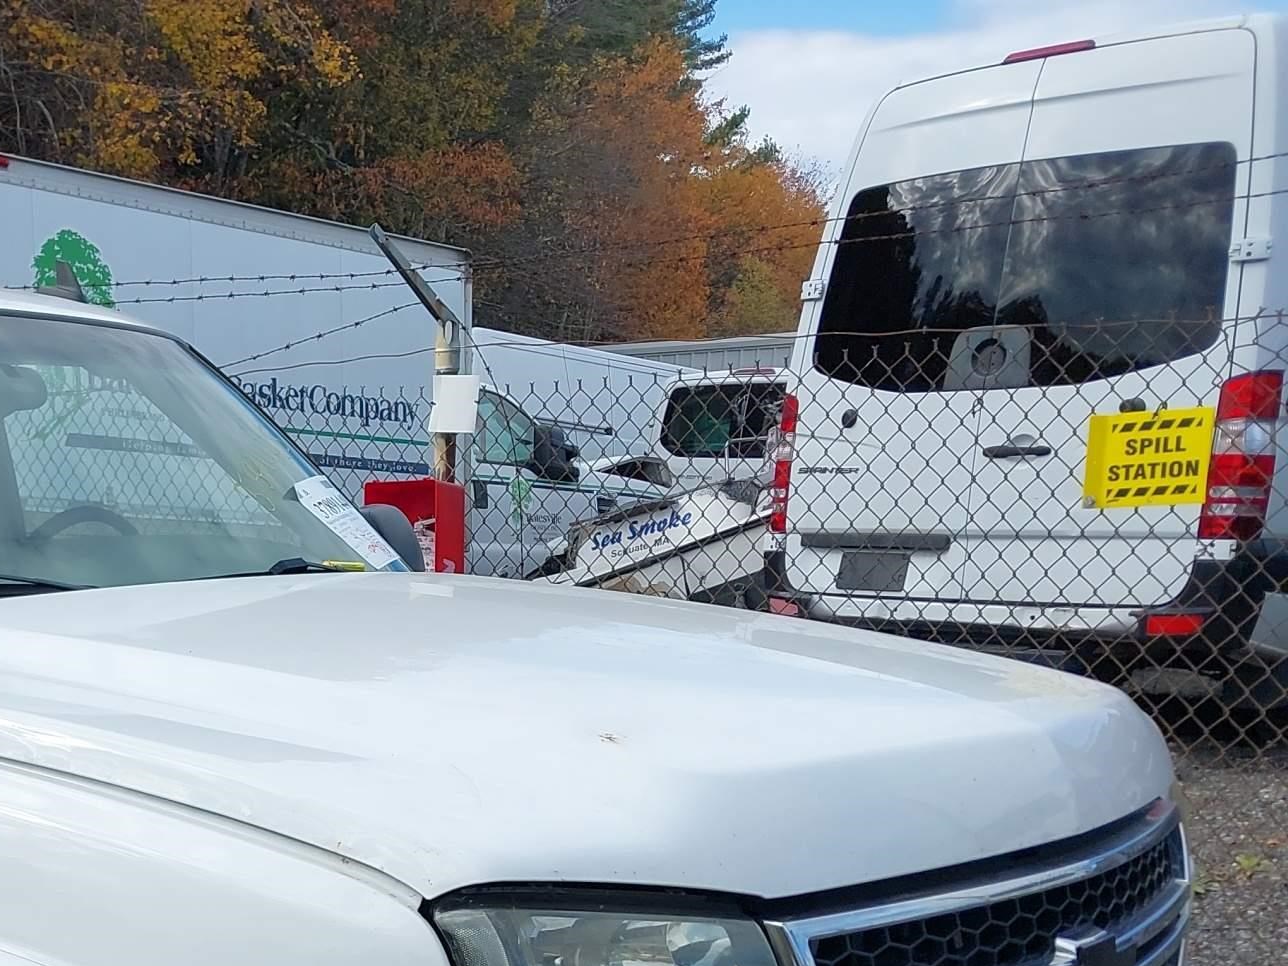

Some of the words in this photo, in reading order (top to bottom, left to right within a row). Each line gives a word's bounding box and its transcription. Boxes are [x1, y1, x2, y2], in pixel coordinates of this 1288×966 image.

[1125, 435, 1186, 455] SPILL
[1107, 459, 1200, 481] STATION
[591, 531, 623, 550] Sea
[627, 510, 692, 539] Smoke
